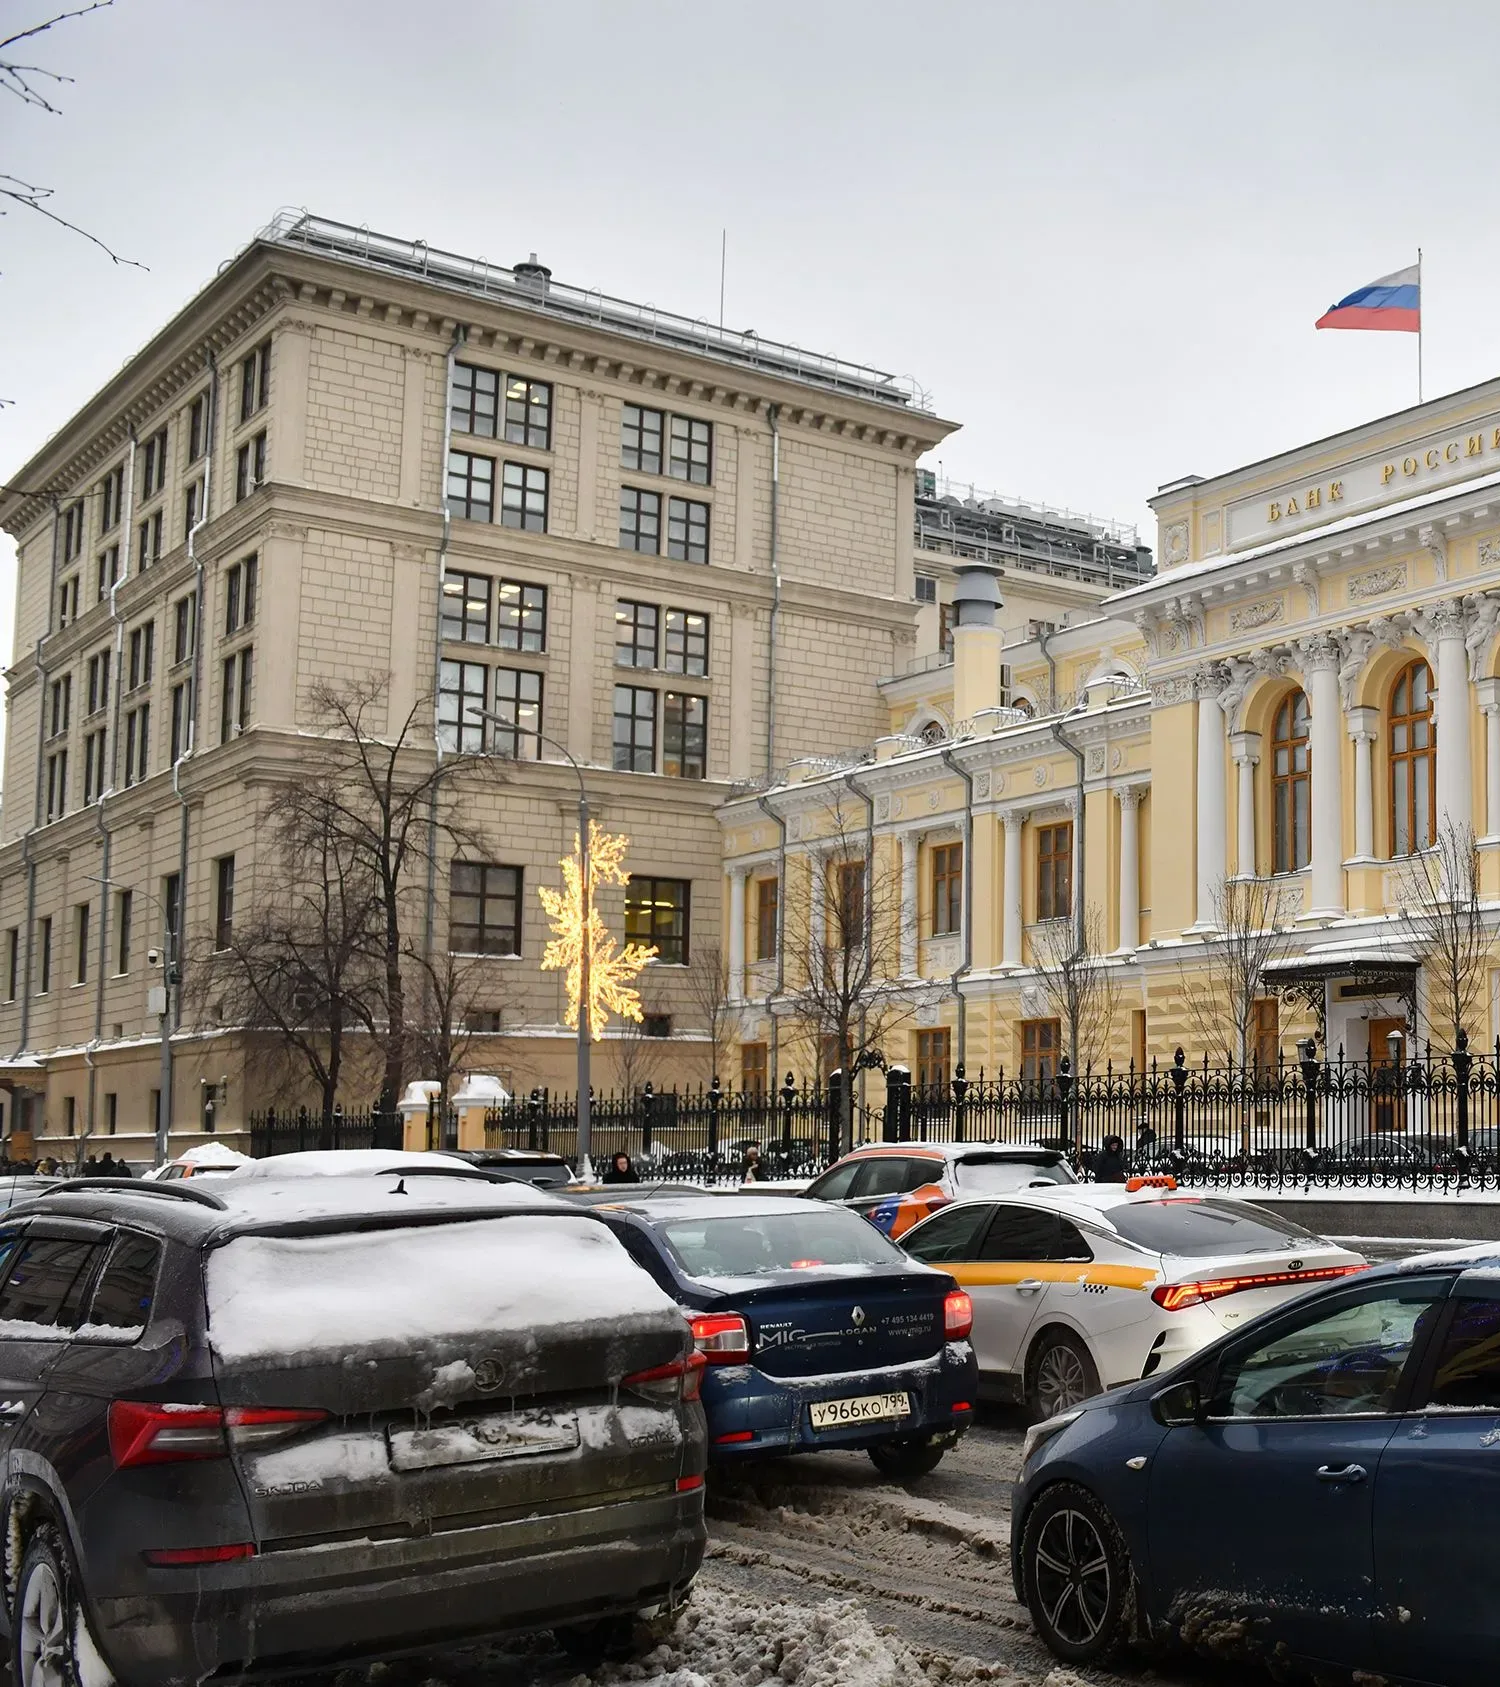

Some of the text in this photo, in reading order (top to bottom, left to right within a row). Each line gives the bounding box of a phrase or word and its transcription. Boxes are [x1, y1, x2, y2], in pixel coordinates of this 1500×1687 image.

[1266, 480, 1344, 523] БАНК
[1289, 1260, 1303, 1269] KIA
[892, 1315, 905, 1324] 495
[759, 1321, 793, 1330] RENAULT
[839, 1326, 877, 1336] LOGAN
